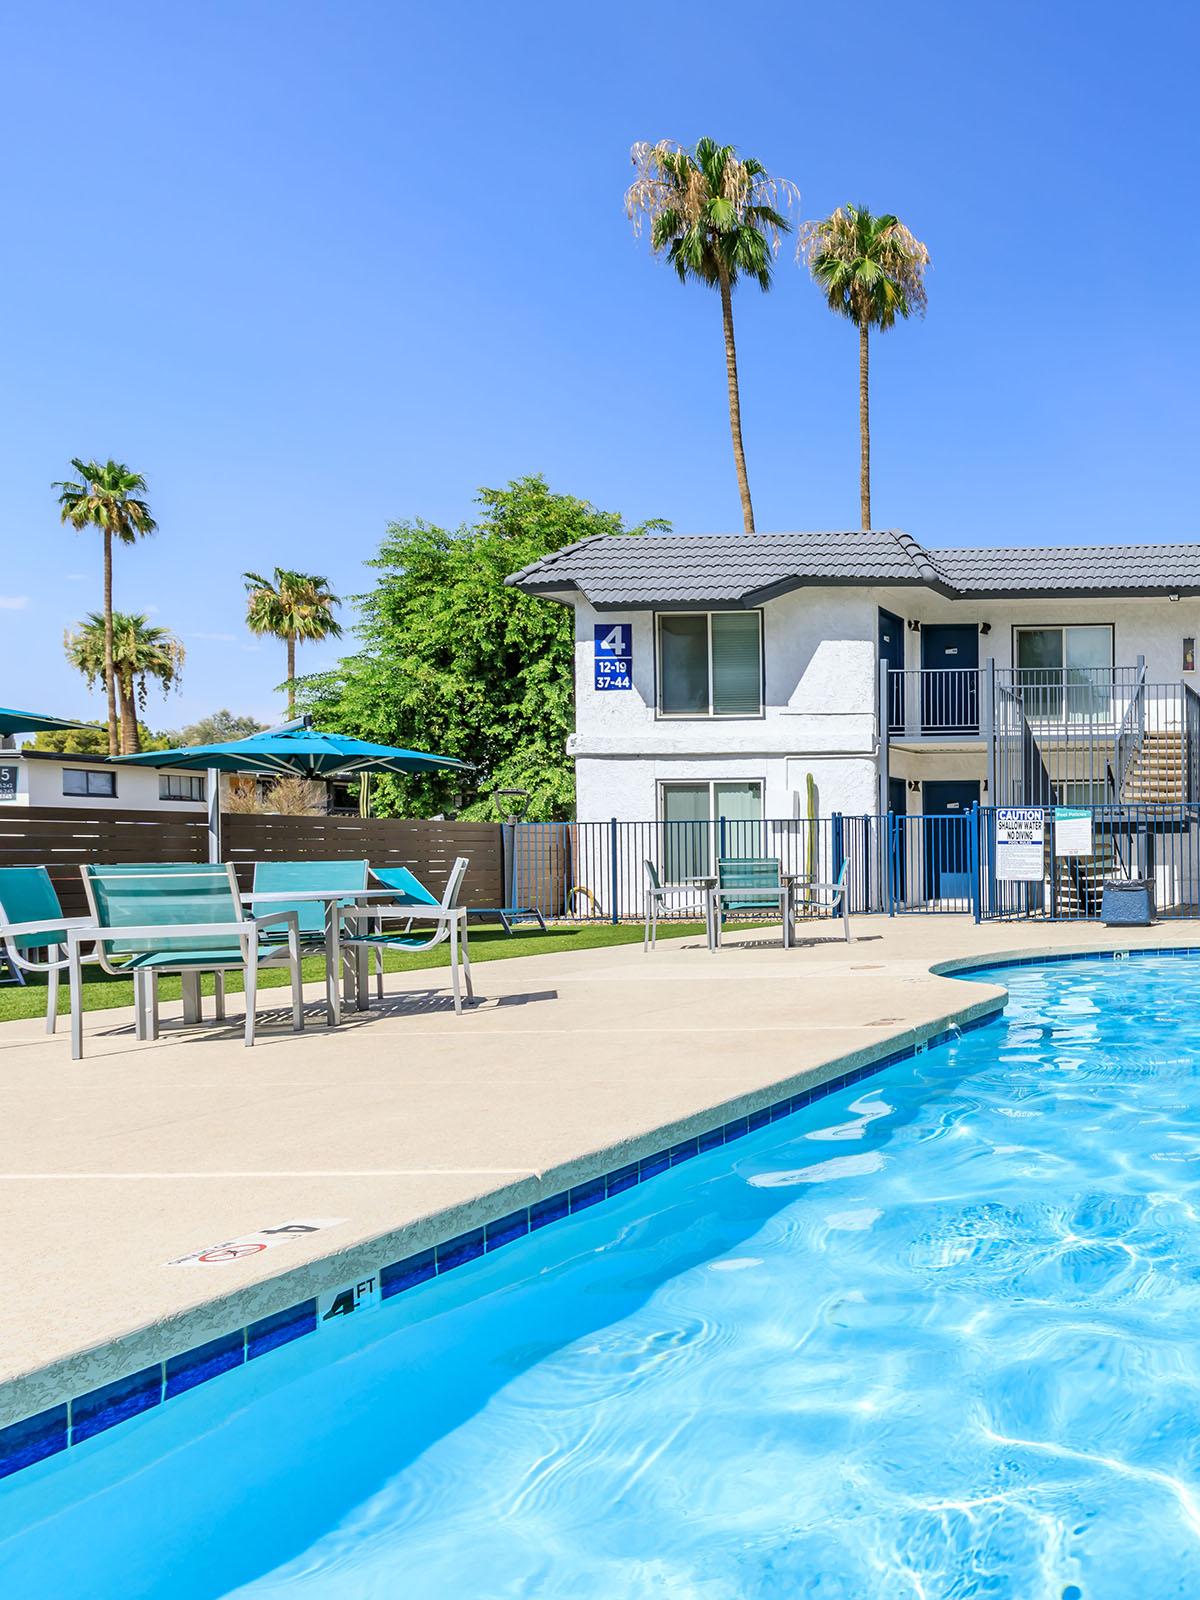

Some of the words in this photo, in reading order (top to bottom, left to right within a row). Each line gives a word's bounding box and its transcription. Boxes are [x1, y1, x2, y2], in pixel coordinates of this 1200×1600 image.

[600, 626, 626, 655] 4
[599, 662, 627, 673] 12-19
[597, 677, 630, 688] 37-44
[1, 769, 10, 781] 5
[999, 810, 1041, 820] CAUTION
[998, 821, 1023, 830] SHALLOW
[1024, 821, 1042, 830] WATER
[1007, 831, 1015, 840] NO
[1016, 831, 1033, 840] DIVING
[322, 1287, 360, 1321] 4
[357, 1277, 376, 1299] FT
